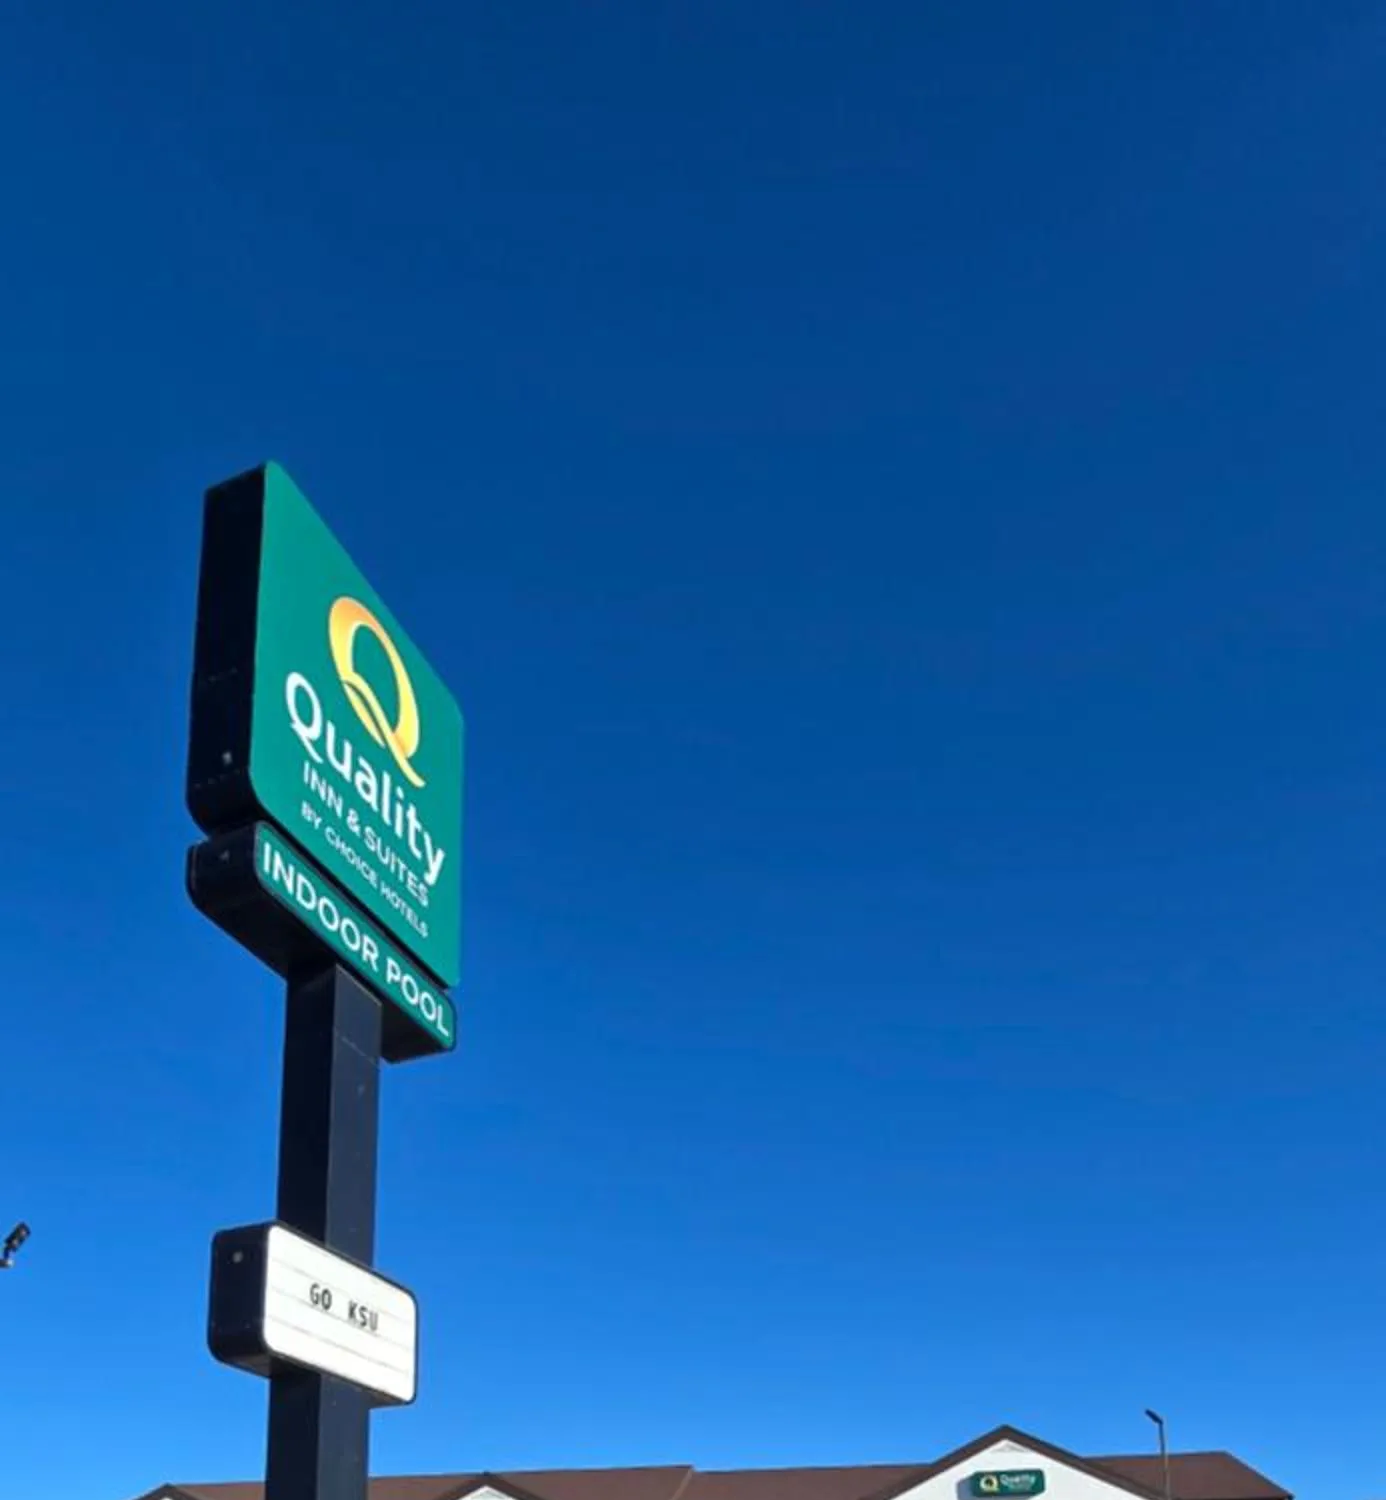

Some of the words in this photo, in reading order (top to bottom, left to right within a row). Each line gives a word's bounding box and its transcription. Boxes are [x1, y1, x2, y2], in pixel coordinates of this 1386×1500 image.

[285, 671, 445, 886] Quality
[303, 760, 343, 818] INN
[346, 808, 361, 837] &
[364, 826, 429, 908] SUITES
[263, 841, 379, 972] INDOOR
[386, 956, 450, 1037] POOL
[302, 800, 322, 830] BY
[324, 826, 379, 889] CHOICE
[380, 881, 429, 939] HOTELS
[309, 1283, 333, 1311] GO
[348, 1298, 379, 1331] KSU
